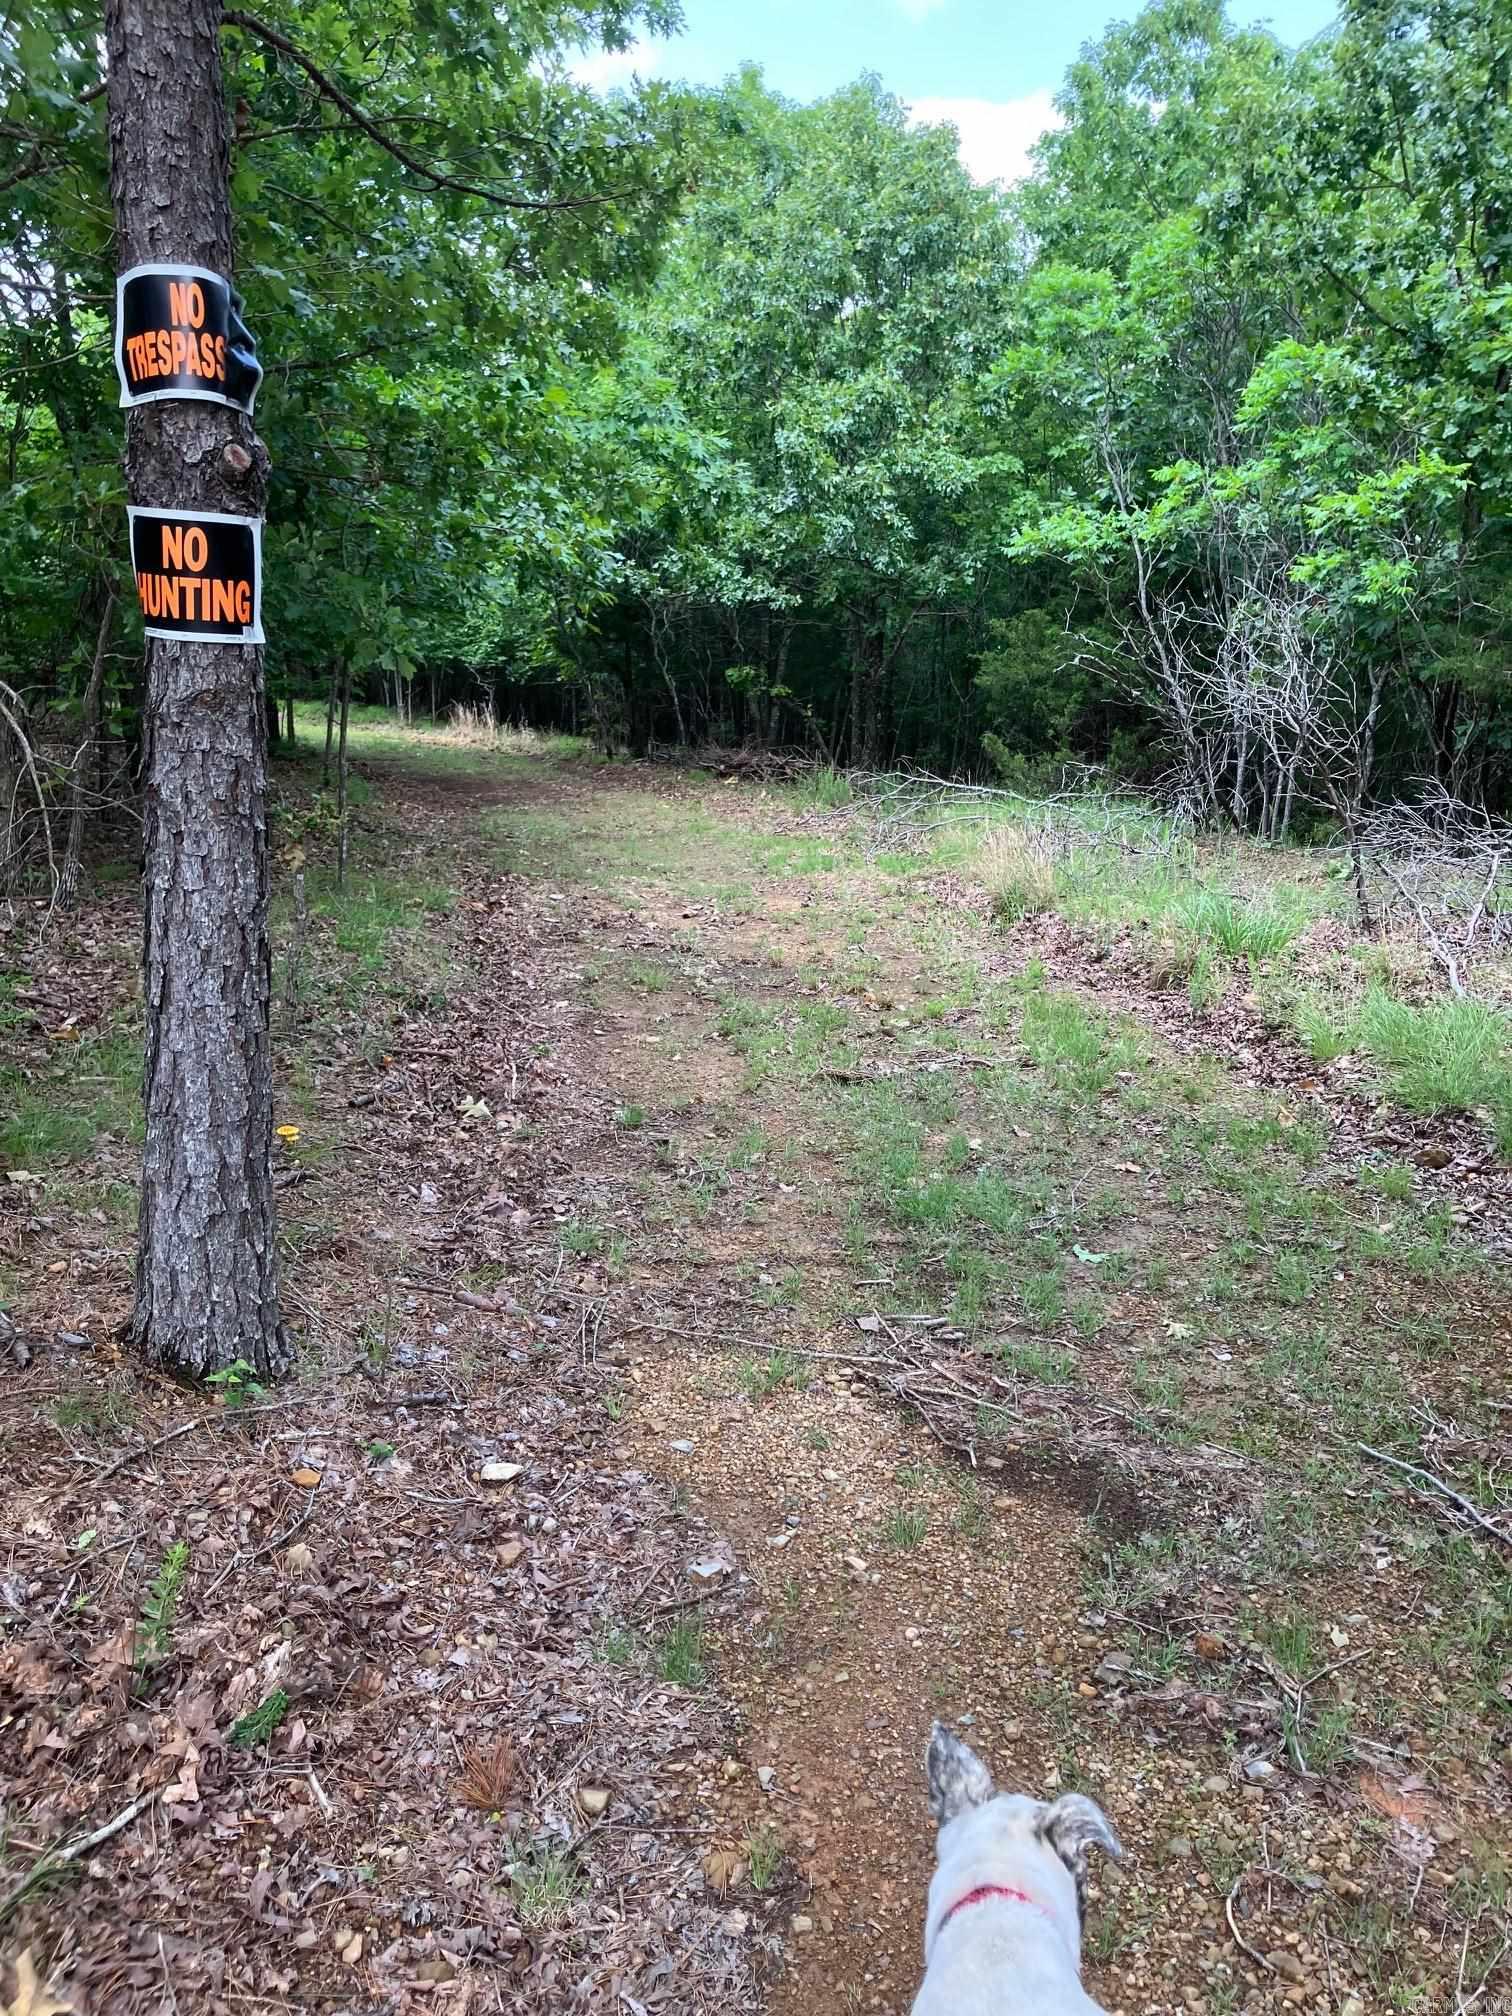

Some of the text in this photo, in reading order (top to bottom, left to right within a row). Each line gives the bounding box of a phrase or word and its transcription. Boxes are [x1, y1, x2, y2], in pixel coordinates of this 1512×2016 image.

[169, 282, 205, 329] NO
[127, 329, 225, 381] TRESPASS
[162, 525, 208, 572] NO
[138, 571, 251, 624] HUNTING
